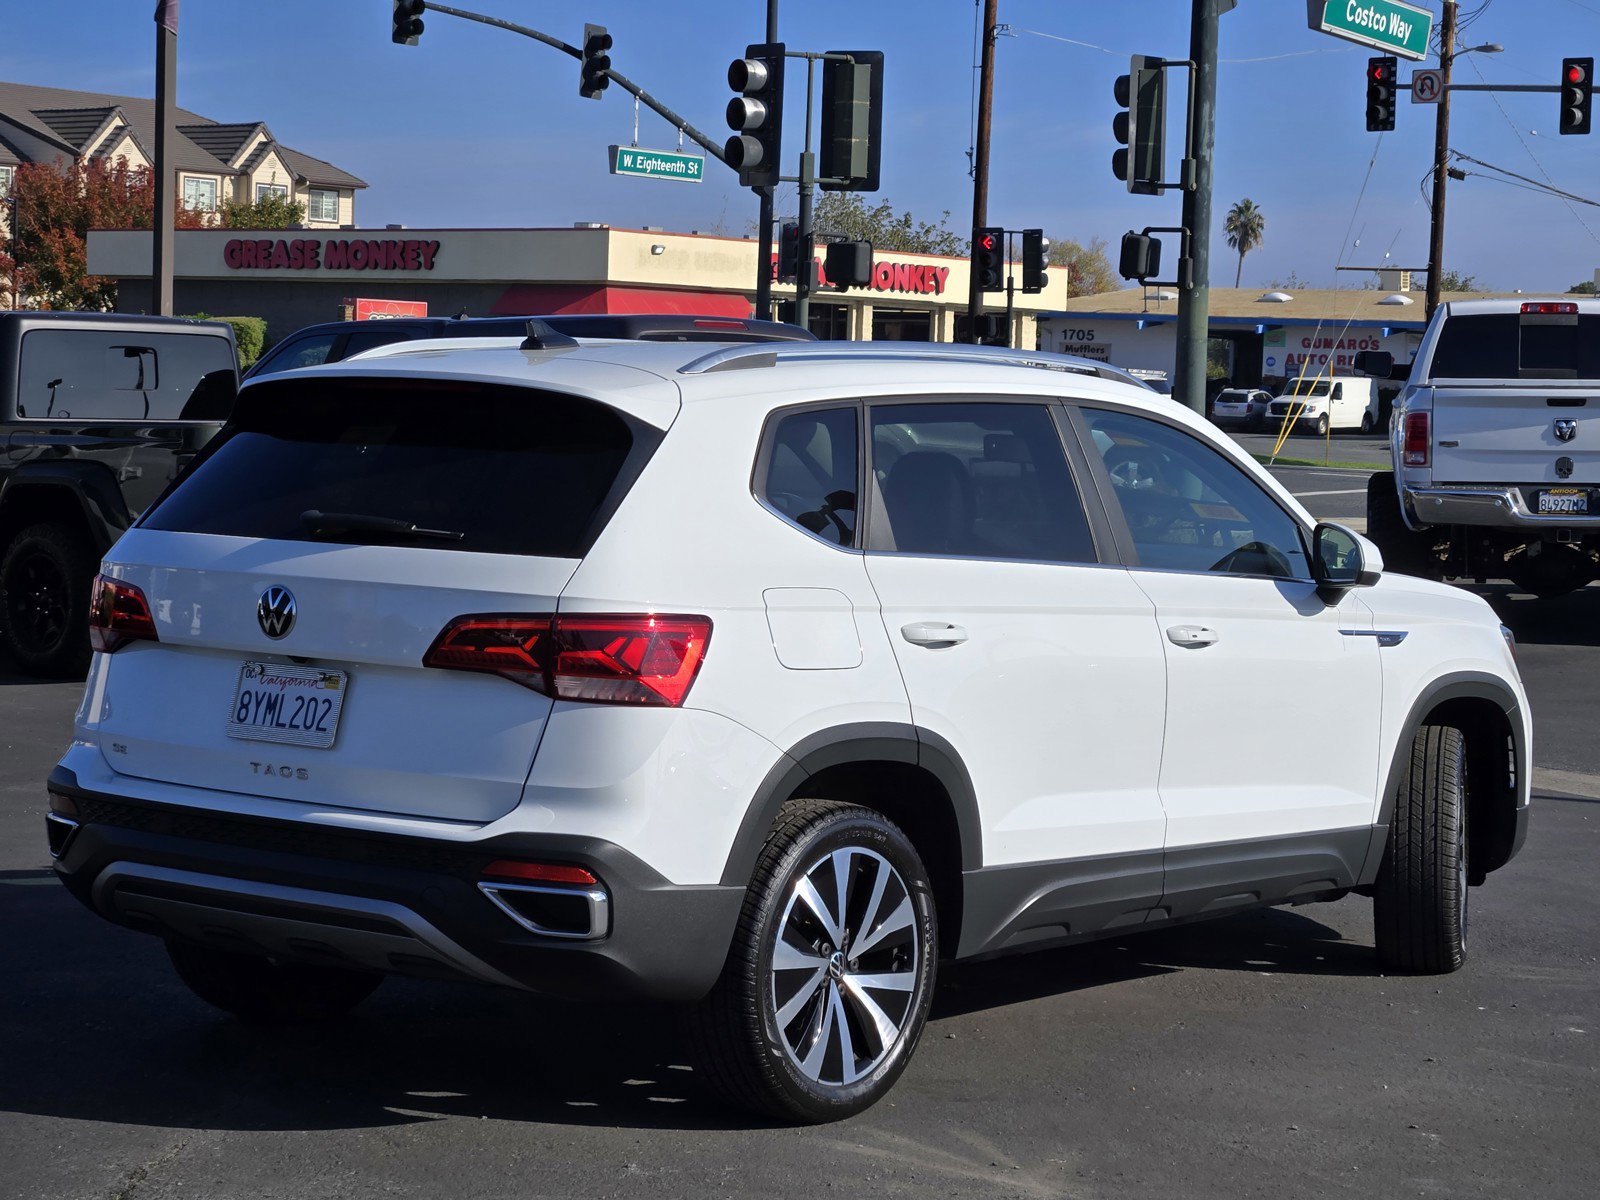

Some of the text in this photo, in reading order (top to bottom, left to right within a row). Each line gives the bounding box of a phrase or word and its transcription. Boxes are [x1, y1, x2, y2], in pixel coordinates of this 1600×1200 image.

[1346, 0, 1412, 45] Costco Way
[623, 154, 698, 174] W. Eighteenth St
[224, 239, 440, 270] GREASE MONKEY
[1062, 329, 1095, 341] 1705
[1302, 335, 1380, 350] GUMARO'S
[1065, 344, 1105, 354] Mufflers
[1285, 353, 1329, 366] AUTO
[236, 690, 333, 732] 8YML202
[250, 762, 309, 780] TAOS
